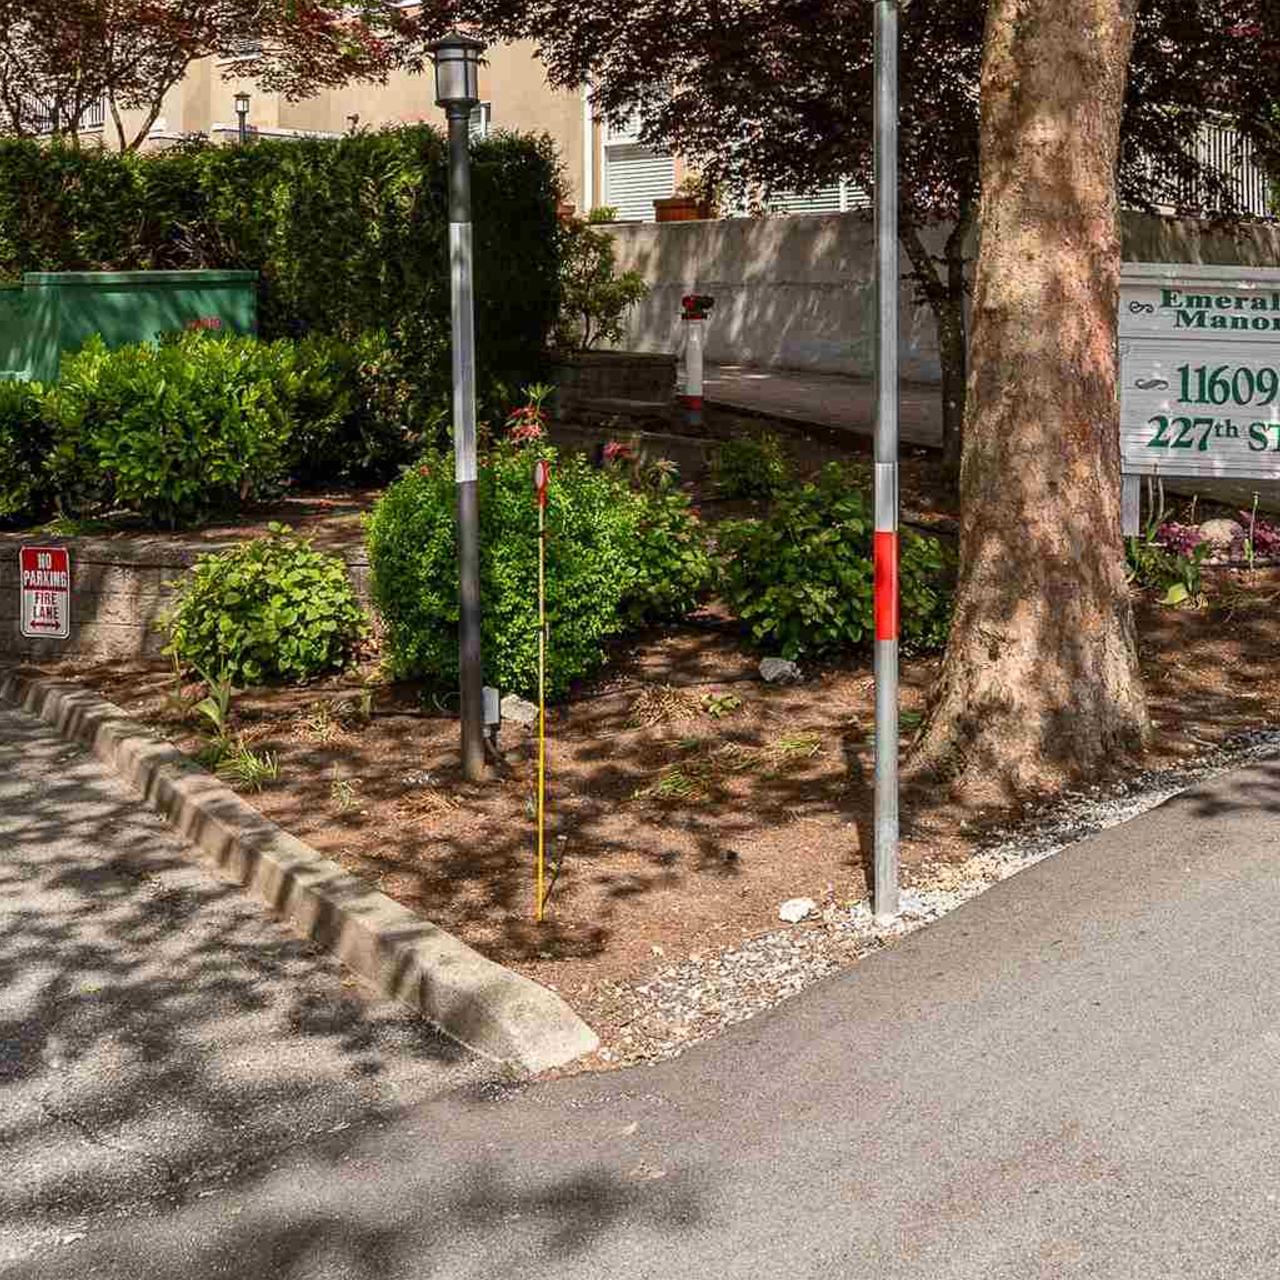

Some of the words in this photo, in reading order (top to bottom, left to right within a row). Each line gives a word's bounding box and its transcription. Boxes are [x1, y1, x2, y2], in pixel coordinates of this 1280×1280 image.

[1177, 364, 1279, 407] 11609
[1147, 416, 1239, 452] 227th
[37, 552, 52, 569] NO
[23, 570, 68, 588] PARKING
[35, 591, 58, 605] FIRE
[33, 606, 60, 620] LANE
